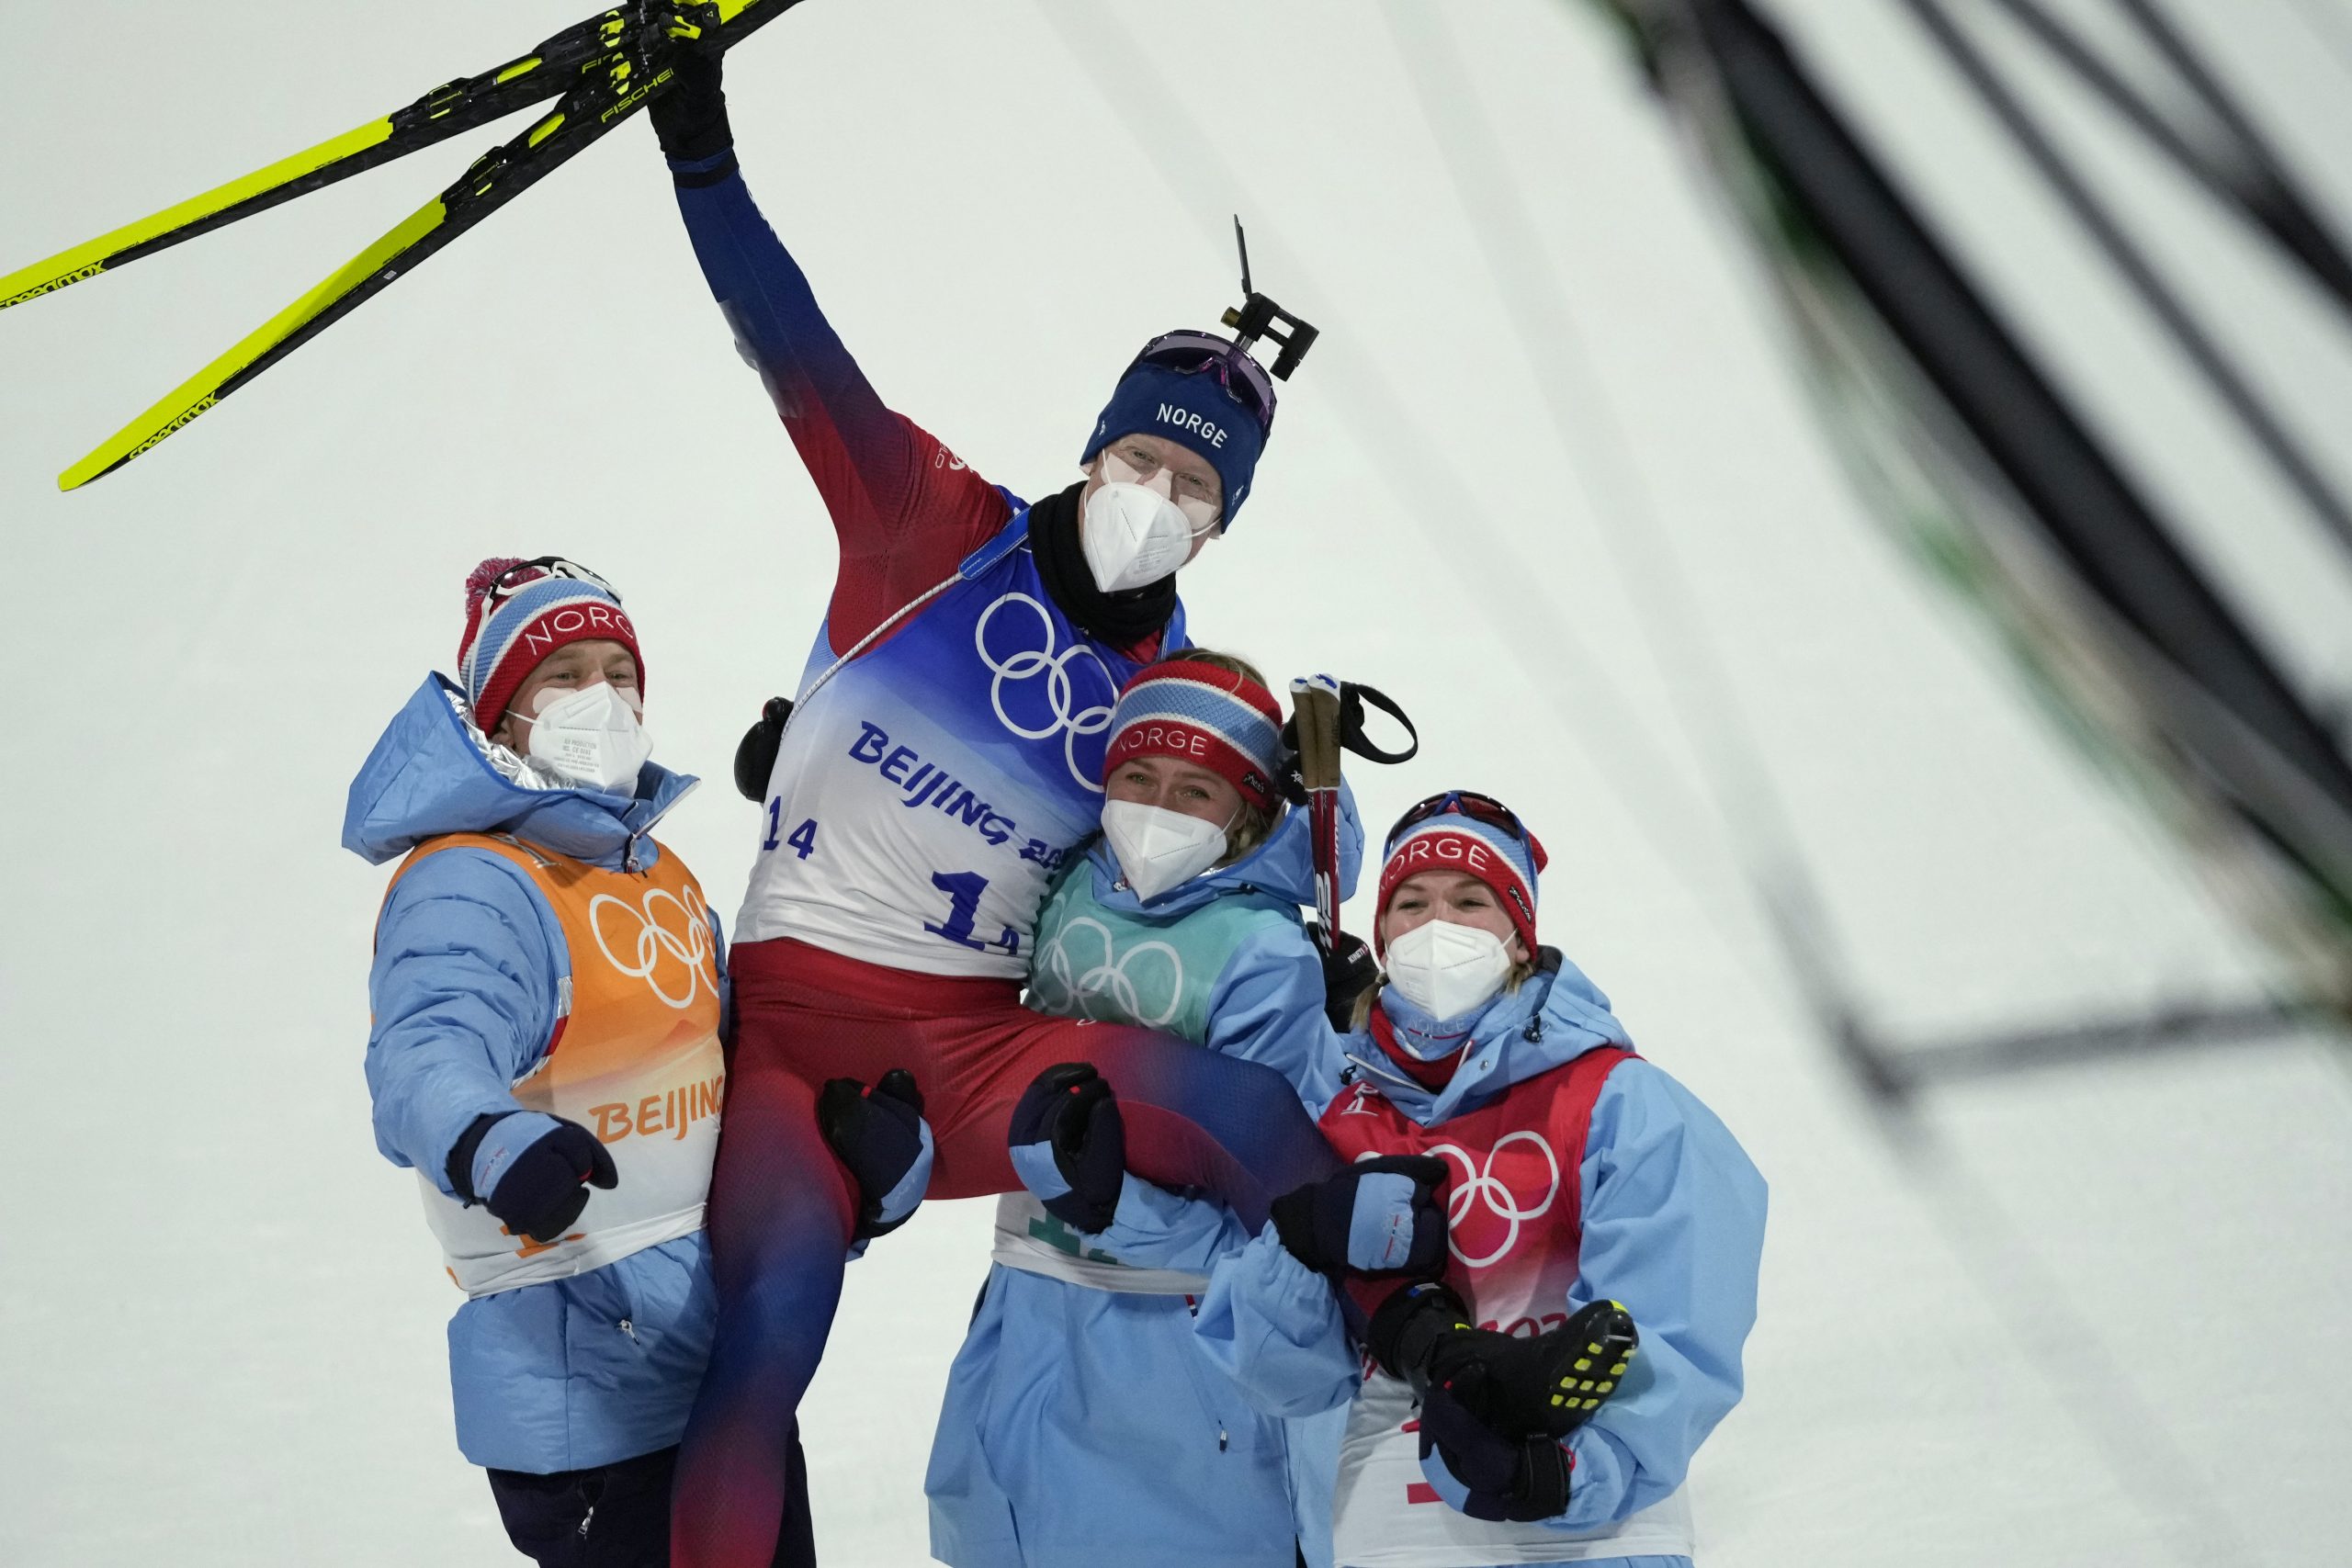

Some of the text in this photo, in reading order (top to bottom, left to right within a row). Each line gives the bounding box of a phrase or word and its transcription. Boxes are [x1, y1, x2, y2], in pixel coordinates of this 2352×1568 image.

[601, 67, 674, 123] FISCHE
[1156, 402, 1228, 448] NORGE
[526, 606, 634, 656] NORG
[1117, 727, 1208, 756] NORGE
[848, 720, 1063, 871] BEIJING 20
[763, 795, 818, 860] 14
